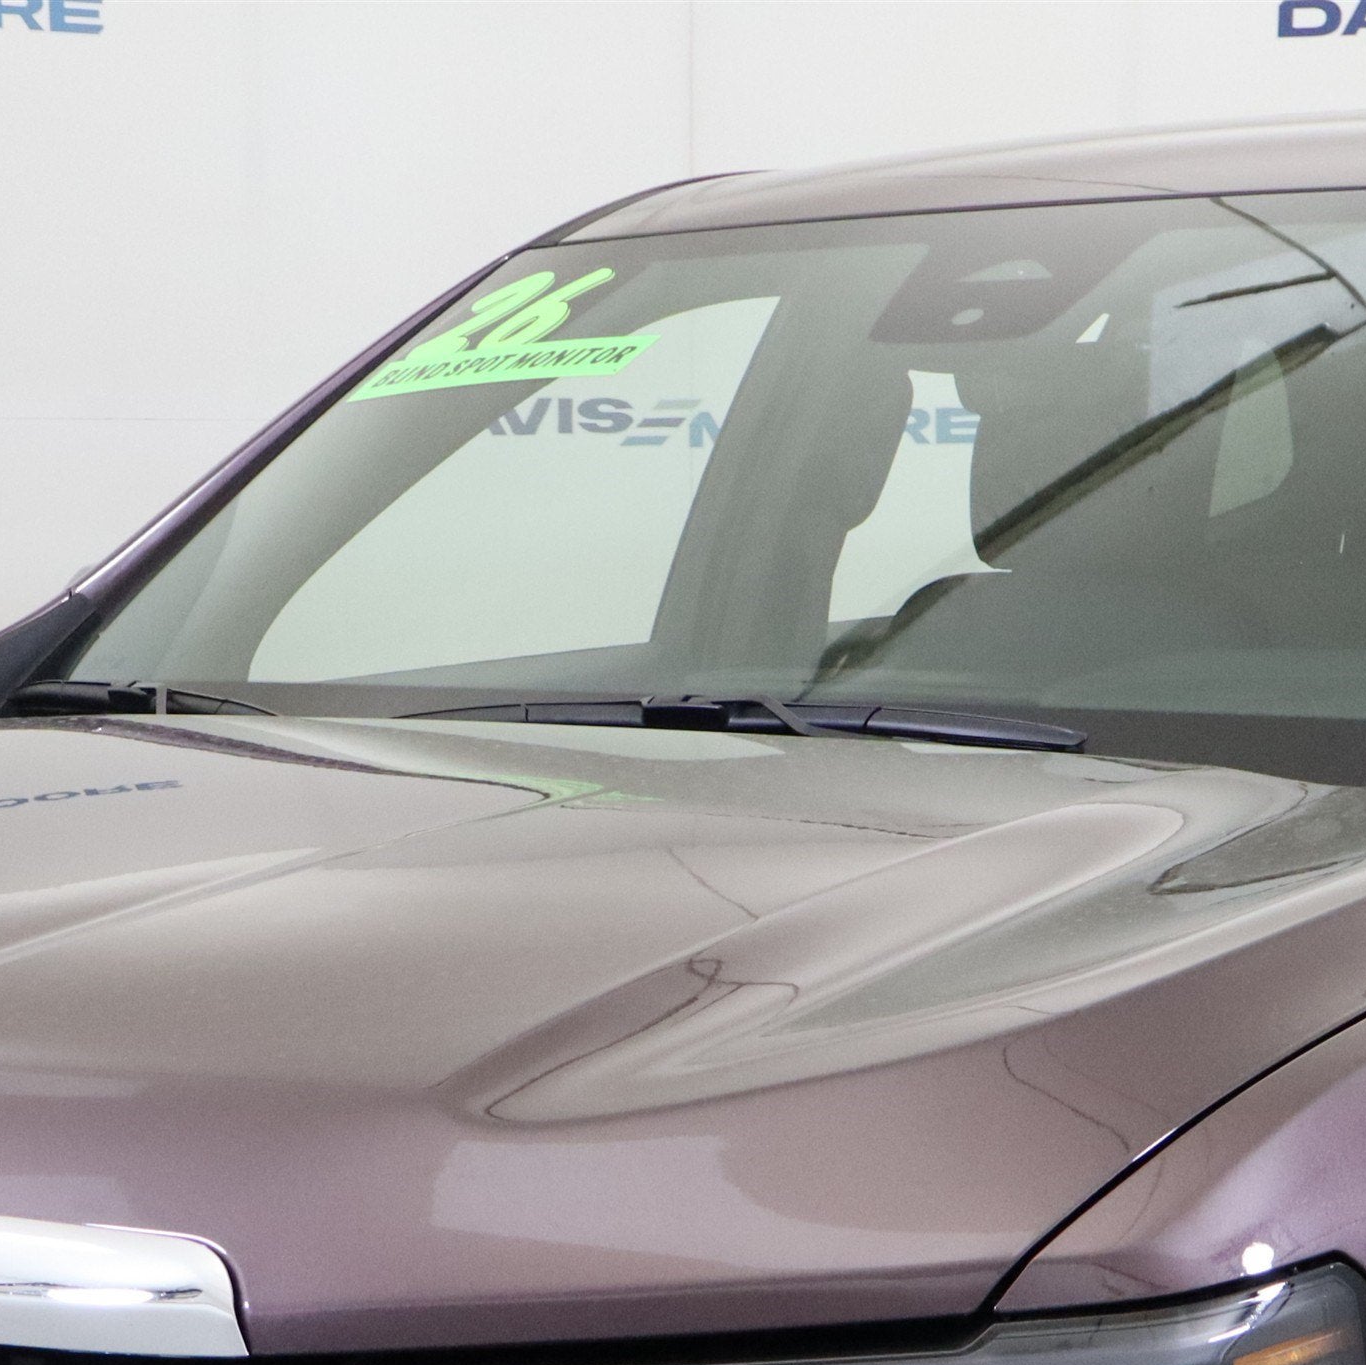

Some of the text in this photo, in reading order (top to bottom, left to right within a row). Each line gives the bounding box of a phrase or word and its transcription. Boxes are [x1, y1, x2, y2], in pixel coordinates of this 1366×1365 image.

[371, 345, 638, 388] BLIND SPOT MONITOR
